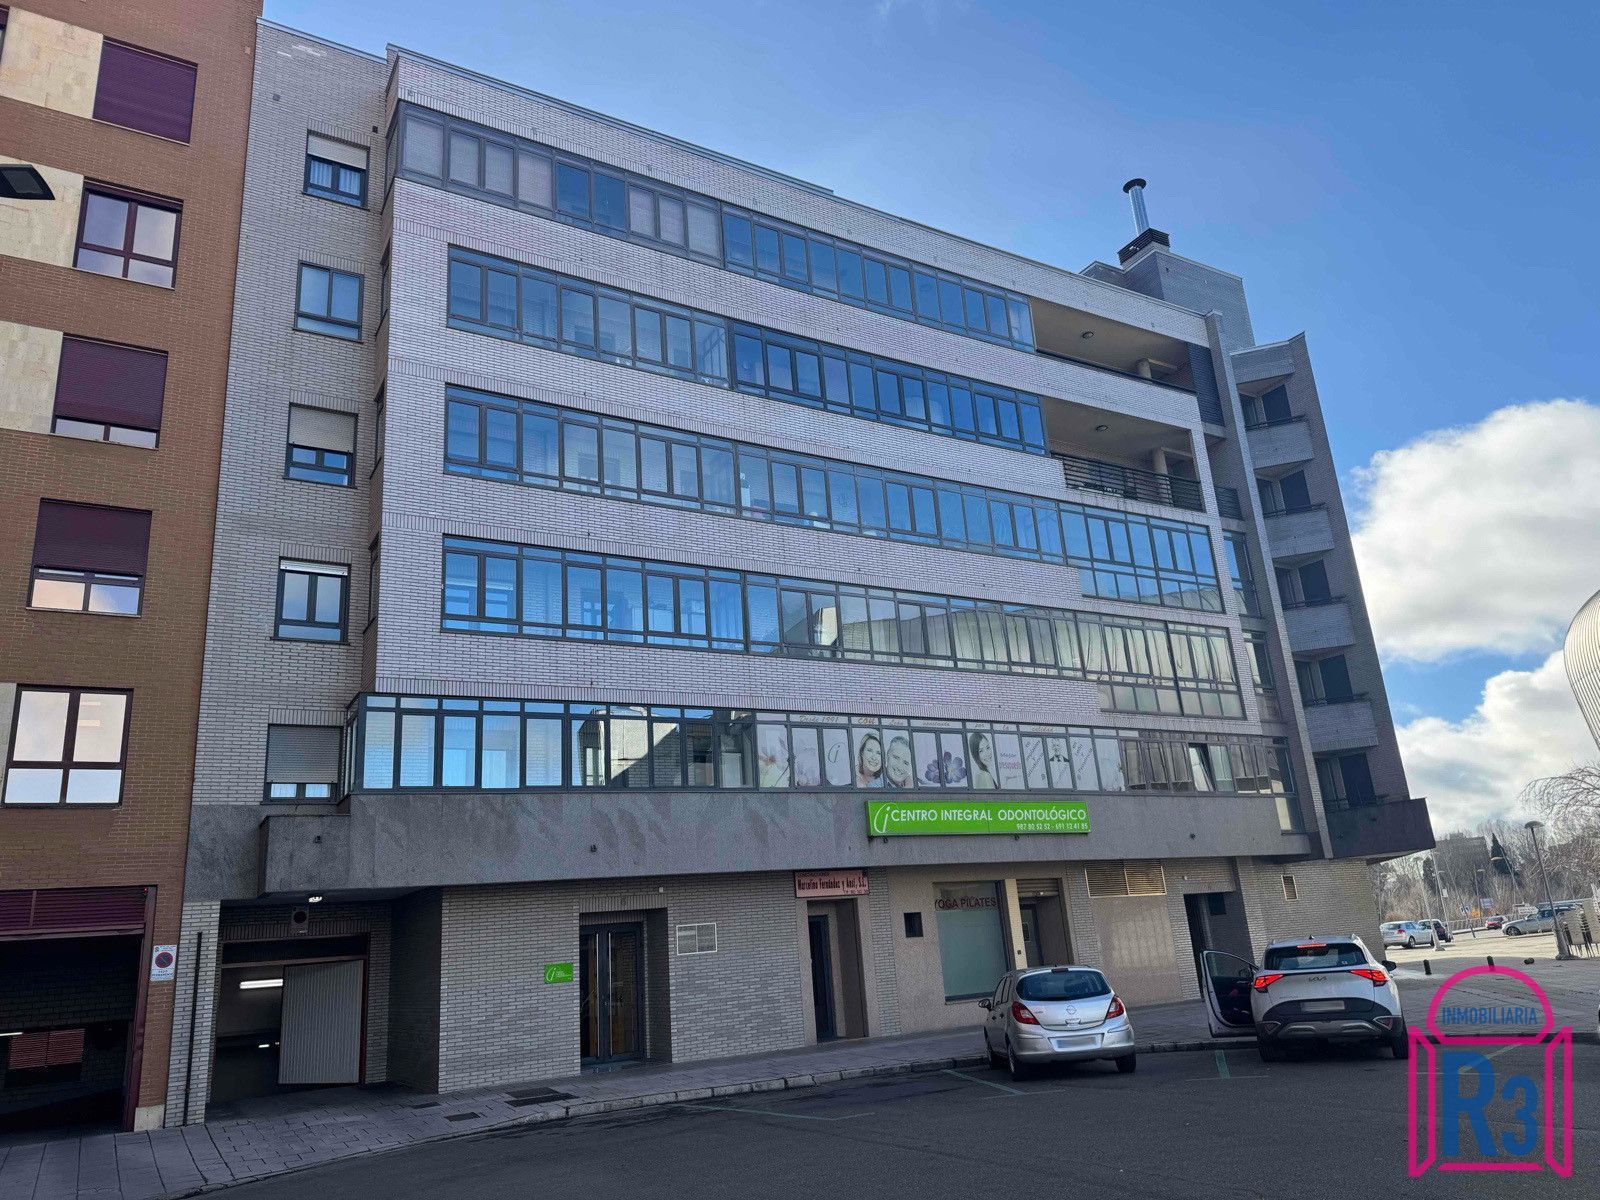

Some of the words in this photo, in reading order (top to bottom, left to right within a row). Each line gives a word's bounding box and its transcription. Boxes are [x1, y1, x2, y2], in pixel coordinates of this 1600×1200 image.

[891, 809, 938, 821] CENTRO
[941, 809, 993, 821] INTEGRAL
[998, 806, 1087, 821] ODONTOLÓGICO
[1016, 823, 1027, 831] 987
[934, 898, 959, 909] YOGA
[961, 897, 997, 907] PILATES
